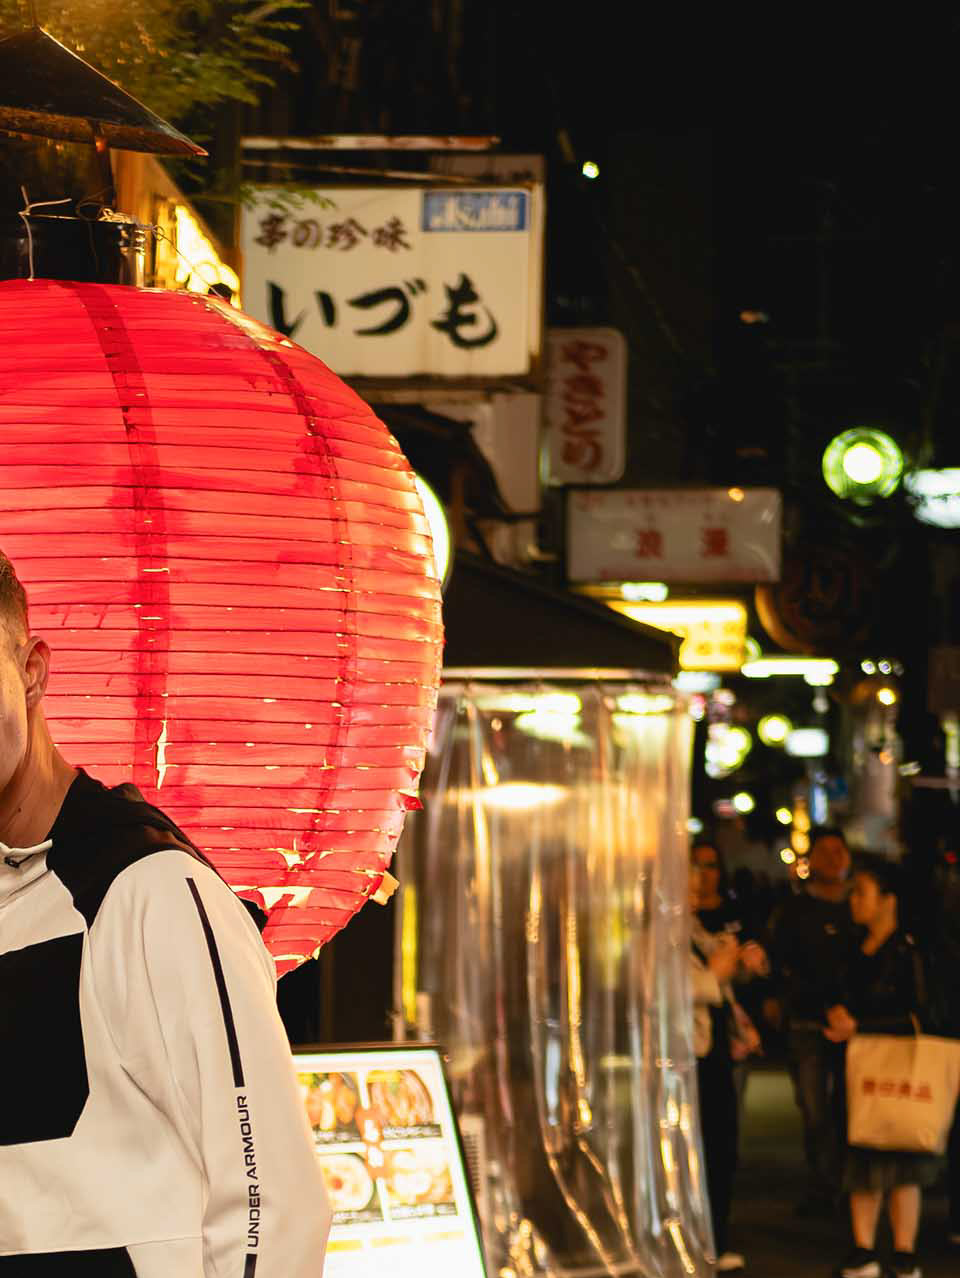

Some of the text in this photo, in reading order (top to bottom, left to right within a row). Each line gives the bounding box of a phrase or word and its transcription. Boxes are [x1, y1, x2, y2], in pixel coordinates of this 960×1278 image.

[266, 272, 499, 350] いづも
[236, 1094, 261, 1248] UNDER ARMOUR
